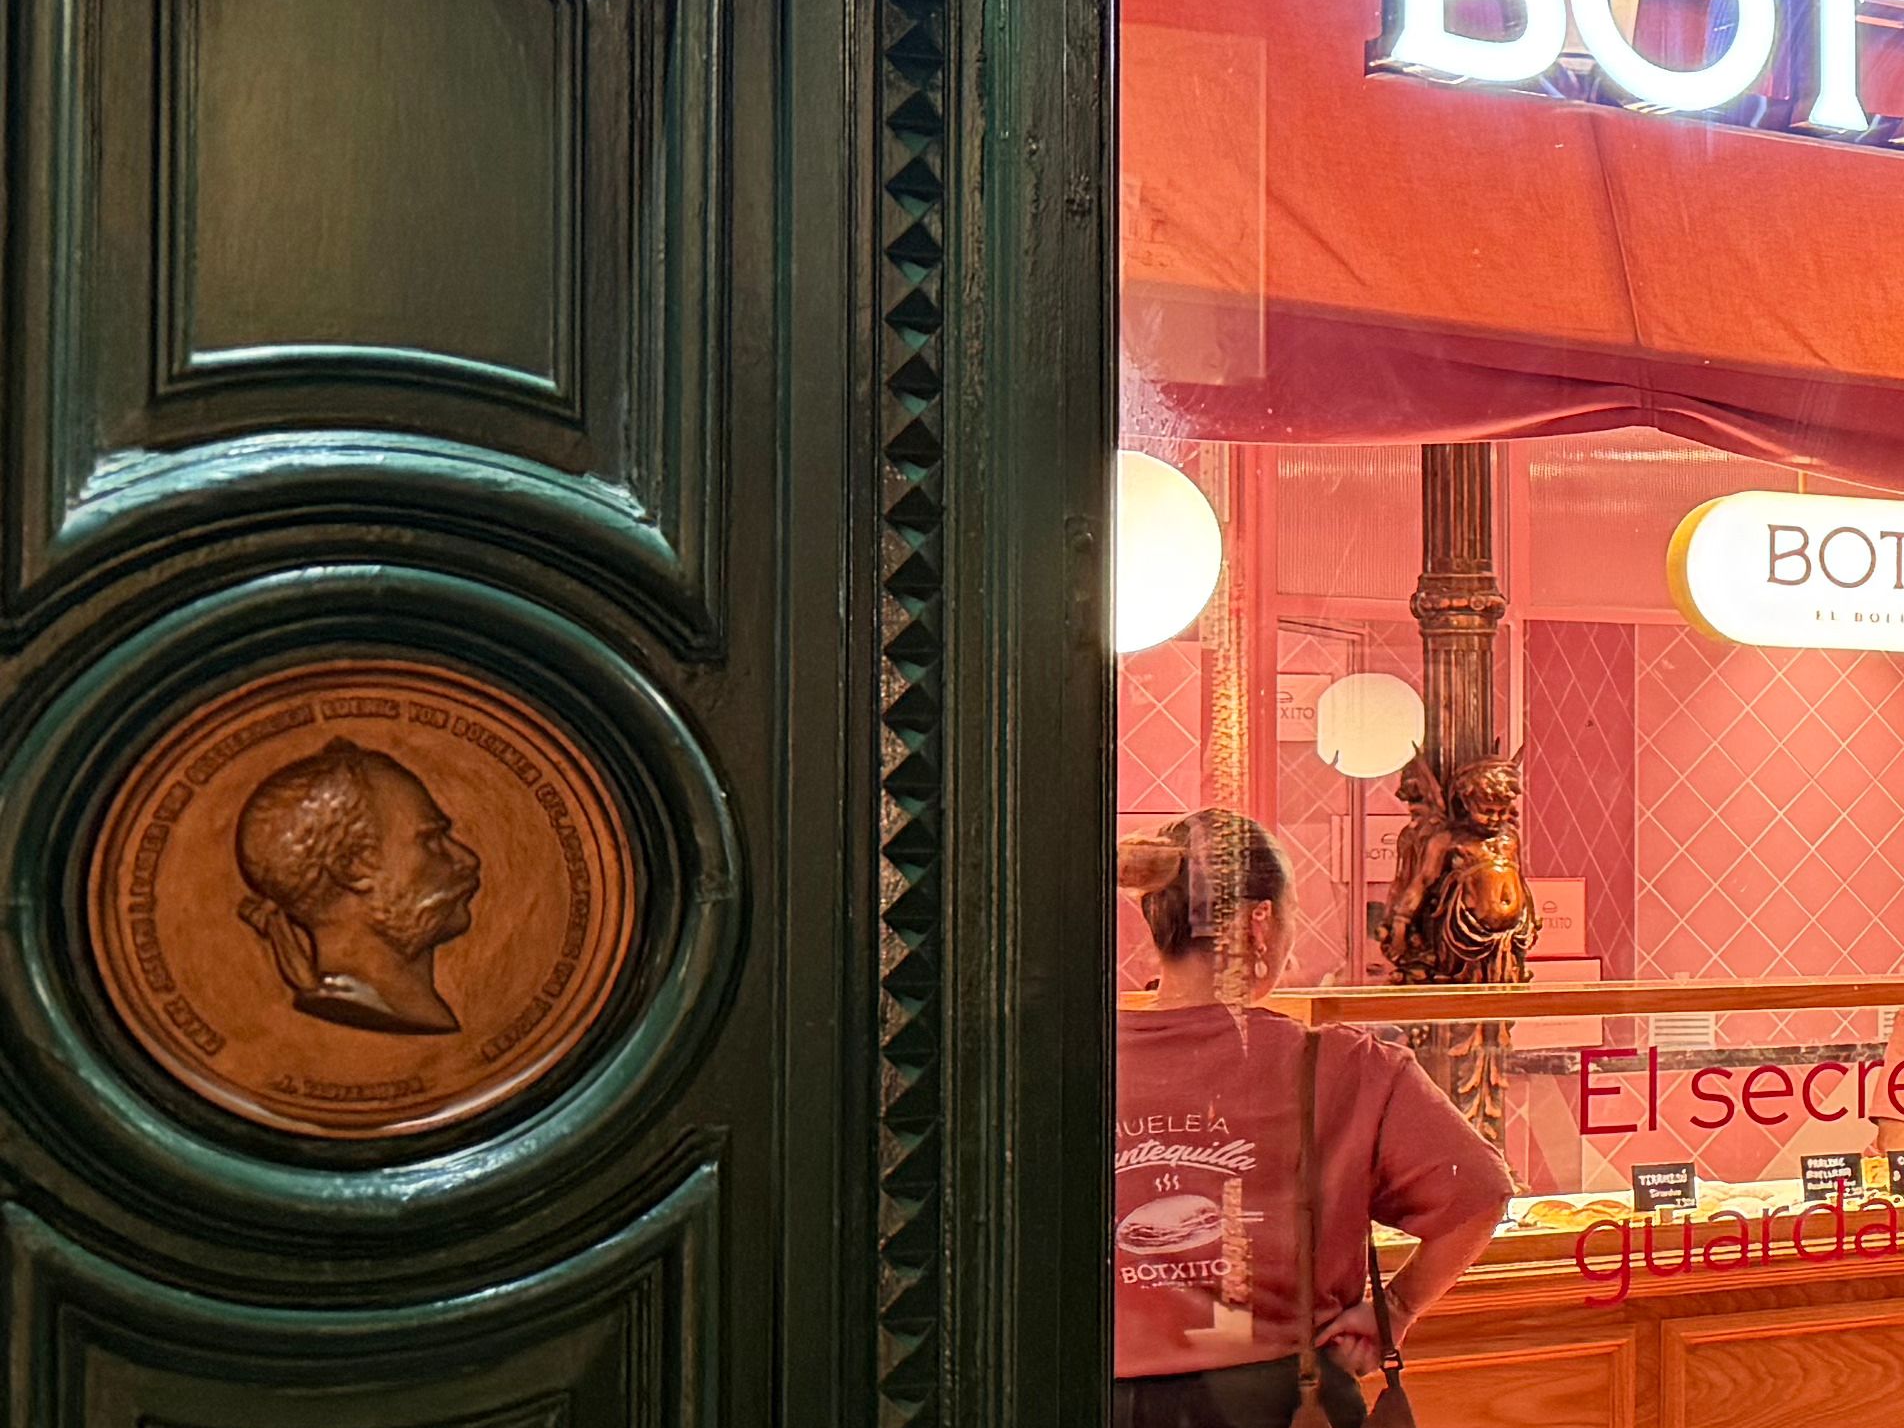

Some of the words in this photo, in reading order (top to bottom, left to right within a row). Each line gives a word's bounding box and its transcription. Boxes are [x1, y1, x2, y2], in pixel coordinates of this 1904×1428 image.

[1816, 610, 1837, 621] EL
[1279, 706, 1315, 720] XITO
[1578, 1045, 1658, 1136] El
[1115, 1113, 1202, 1138] UELE
[1115, 1139, 1257, 1171] ntequilla
[1121, 1257, 1233, 1284] BOTXITO
